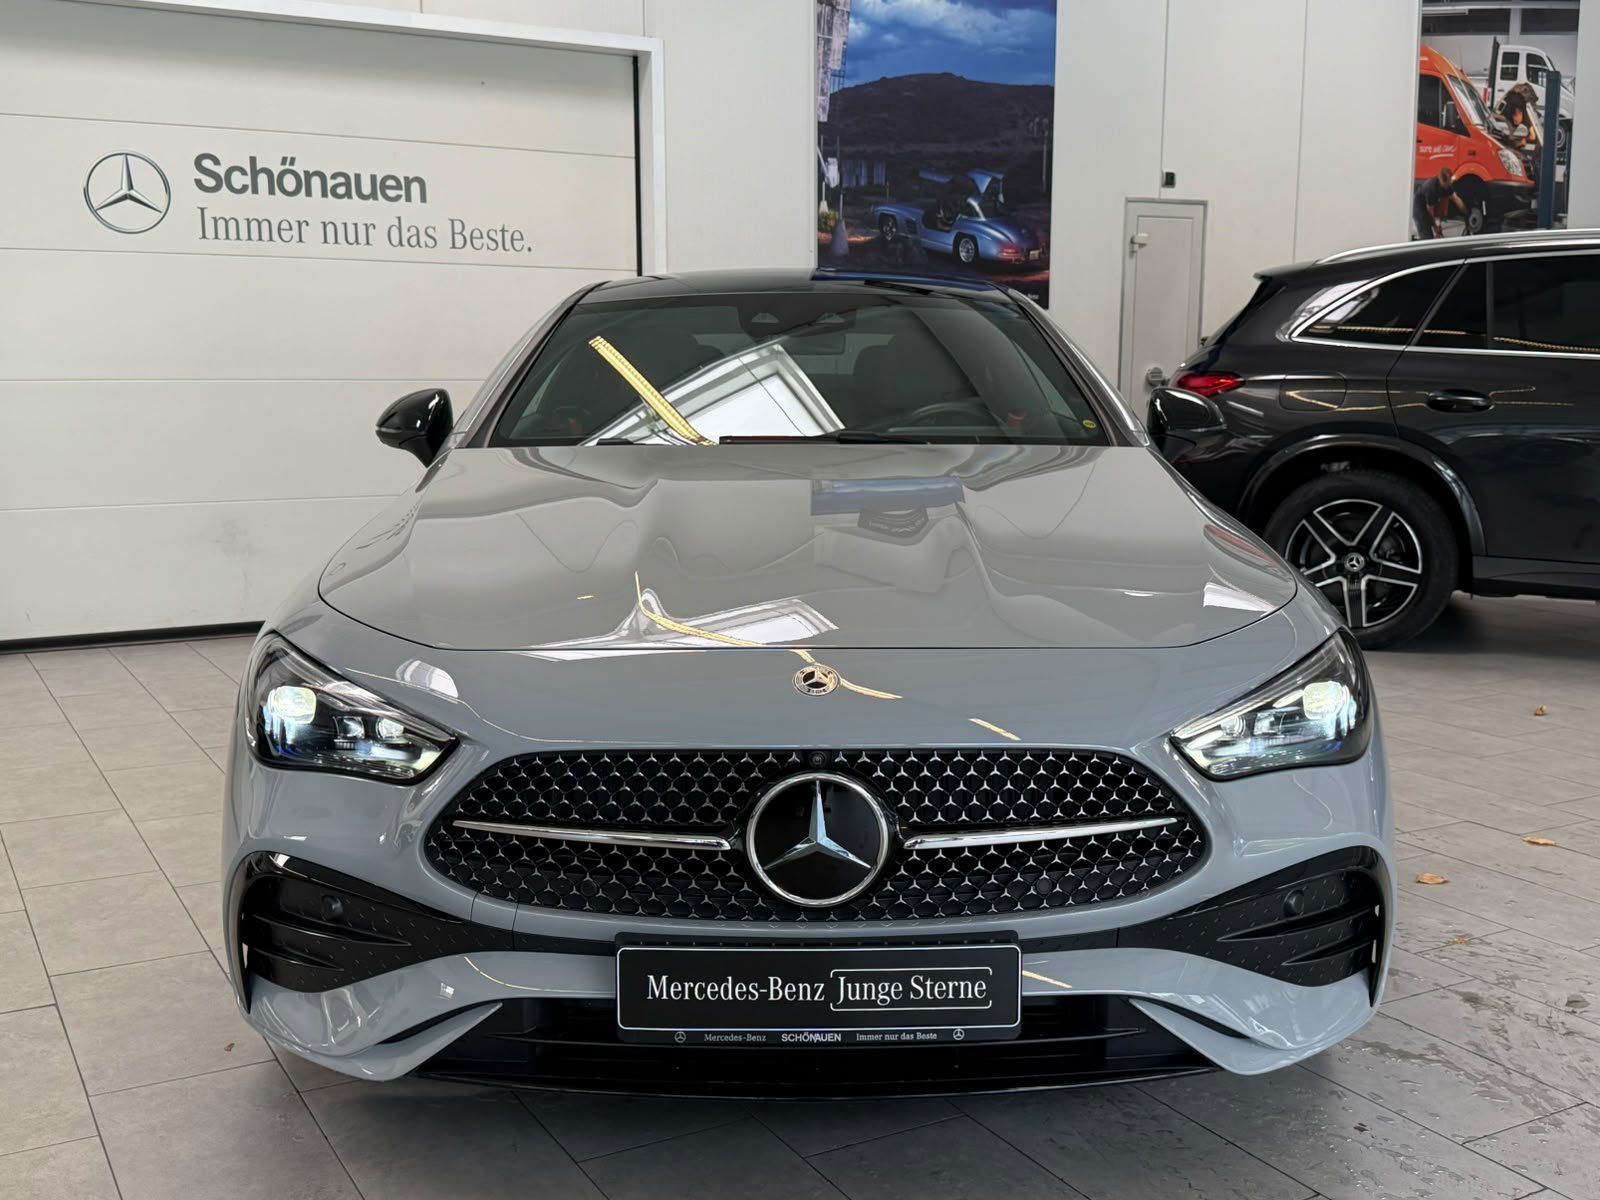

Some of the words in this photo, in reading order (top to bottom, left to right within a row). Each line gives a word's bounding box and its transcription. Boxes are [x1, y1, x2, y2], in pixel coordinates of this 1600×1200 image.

[193, 152, 428, 204] Schönauen
[196, 206, 310, 244] Immer
[320, 219, 377, 247] nur
[387, 215, 438, 249] das
[448, 217, 533, 253] Beste.
[646, 974, 826, 1002] Mercedes-Benz
[835, 976, 903, 1006] Junge
[909, 974, 988, 1000] Sterne
[703, 1033, 767, 1042] Mercedes-Benz
[781, 1031, 842, 1043] SCHÖNAUEN
[856, 1032, 883, 1041] Immer
[884, 1033, 899, 1041] nur
[900, 1031, 915, 1041] das
[916, 1031, 938, 1040] Beste
